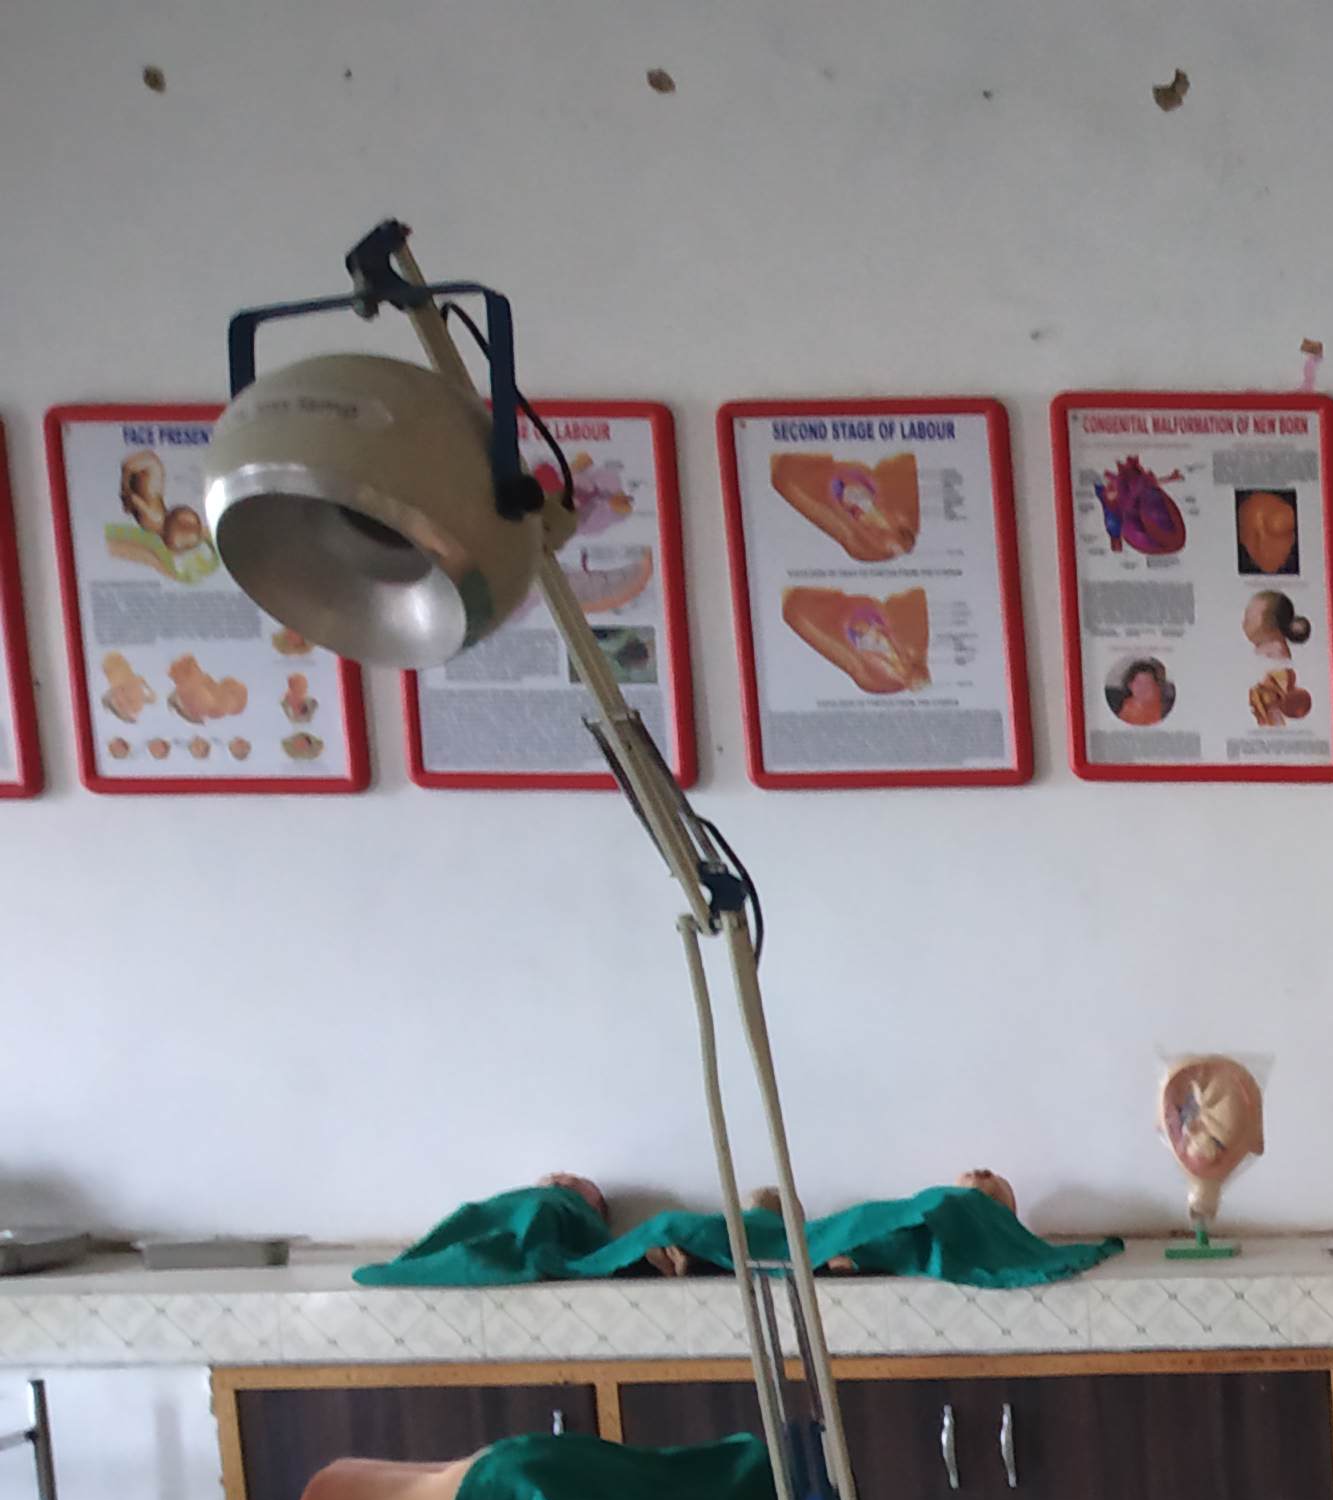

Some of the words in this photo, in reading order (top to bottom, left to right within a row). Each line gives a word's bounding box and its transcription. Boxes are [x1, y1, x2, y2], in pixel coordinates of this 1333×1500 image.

[555, 422, 610, 441] LABOUR
[773, 421, 828, 441] SECOND
[832, 421, 874, 440] STAGE
[879, 421, 895, 440] OF
[900, 421, 956, 440] LABOUR
[1083, 414, 1149, 434] CONGENITAL
[1152, 414, 1234, 434] MALFORMATION
[1237, 415, 1249, 433] OF
[1253, 416, 1276, 434] NEW
[1280, 416, 1308, 434] BORN
[122, 426, 156, 446] FACE
[159, 425, 211, 445] PRESEN
